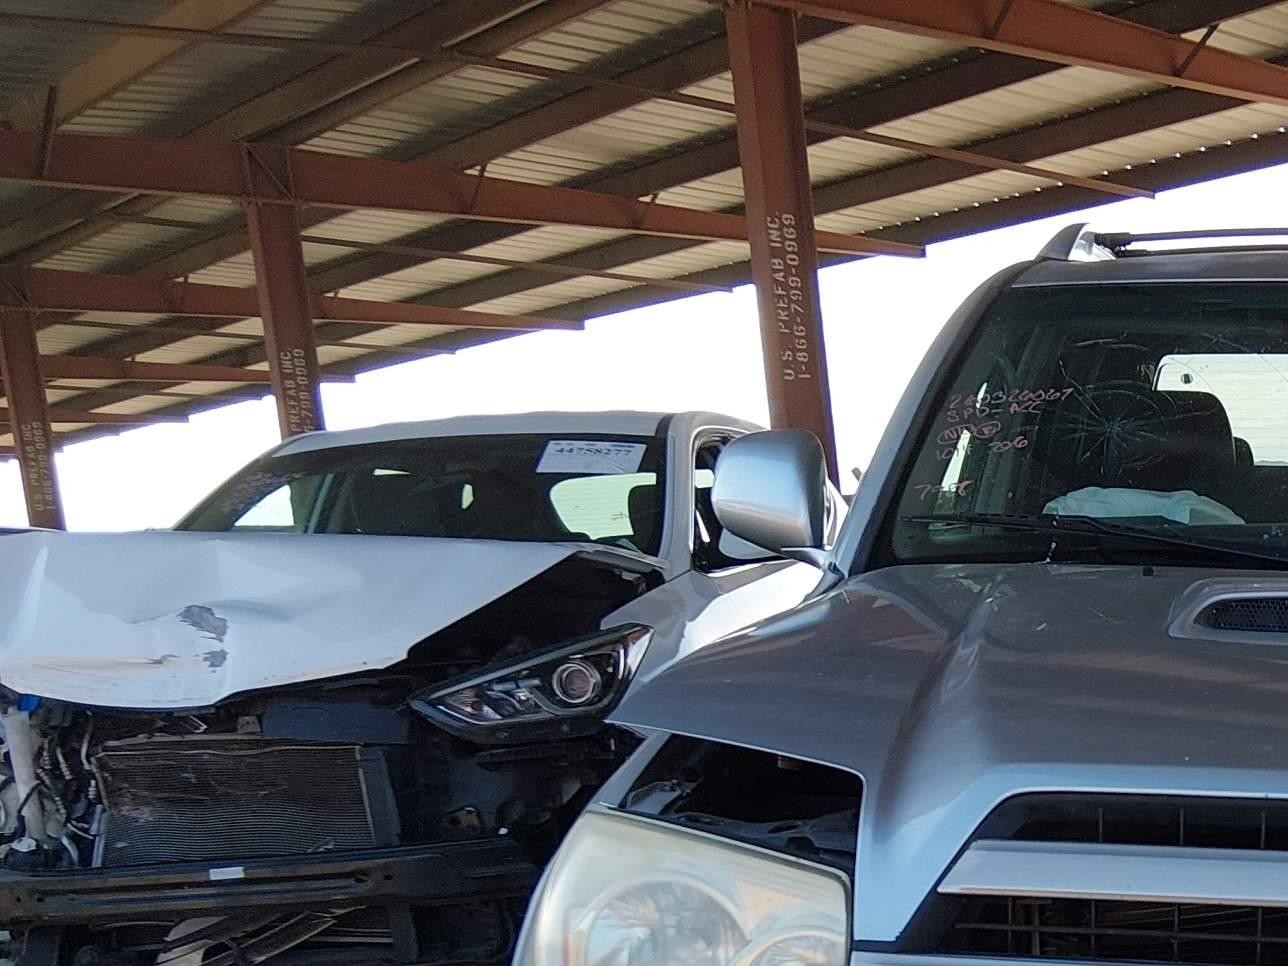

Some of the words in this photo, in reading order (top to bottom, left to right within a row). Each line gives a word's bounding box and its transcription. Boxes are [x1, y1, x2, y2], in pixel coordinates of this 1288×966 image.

[766, 211, 781, 247] INC.
[771, 258, 790, 333] PREFAB
[782, 213, 811, 380] 1-866-799-0969
